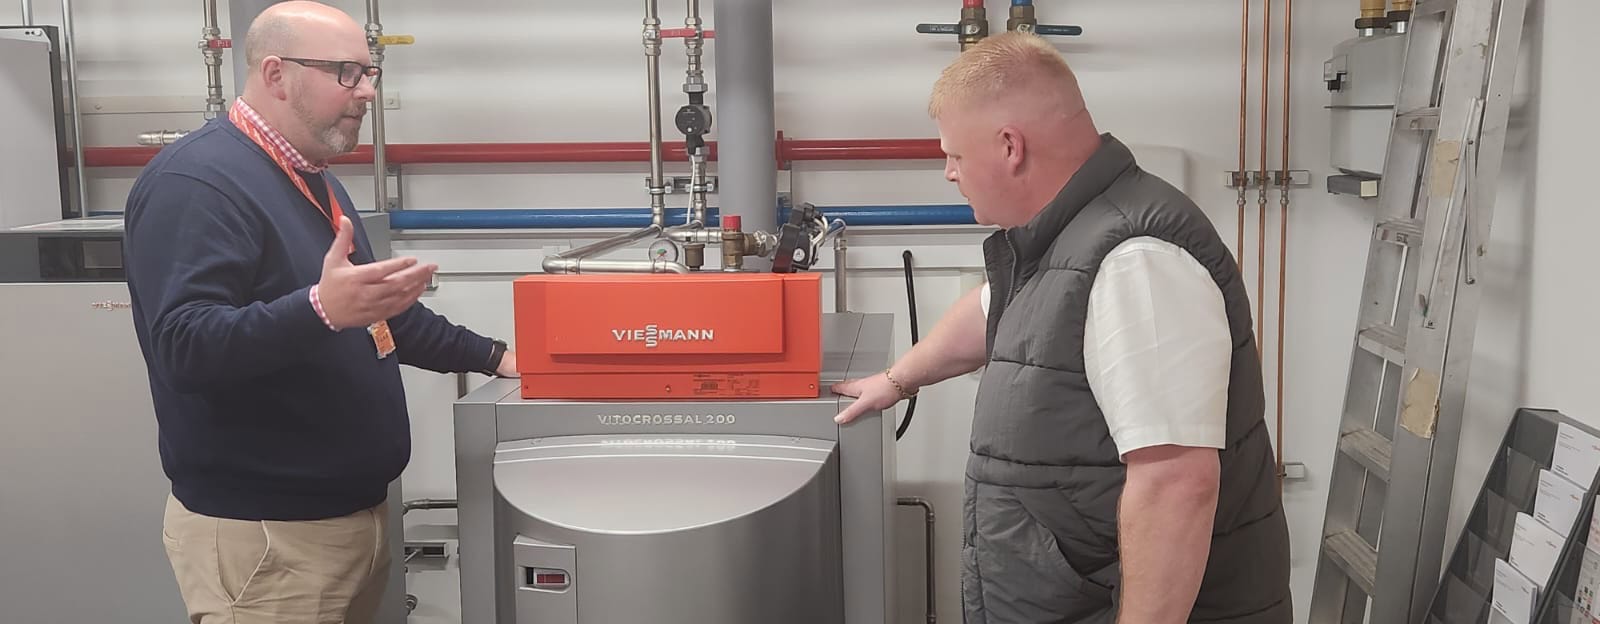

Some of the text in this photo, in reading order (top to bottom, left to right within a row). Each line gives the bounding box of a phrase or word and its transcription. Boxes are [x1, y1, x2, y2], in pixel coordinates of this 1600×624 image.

[611, 324, 714, 347] VIESSMANN
[597, 414, 736, 425] VITOCROSSAL 200
